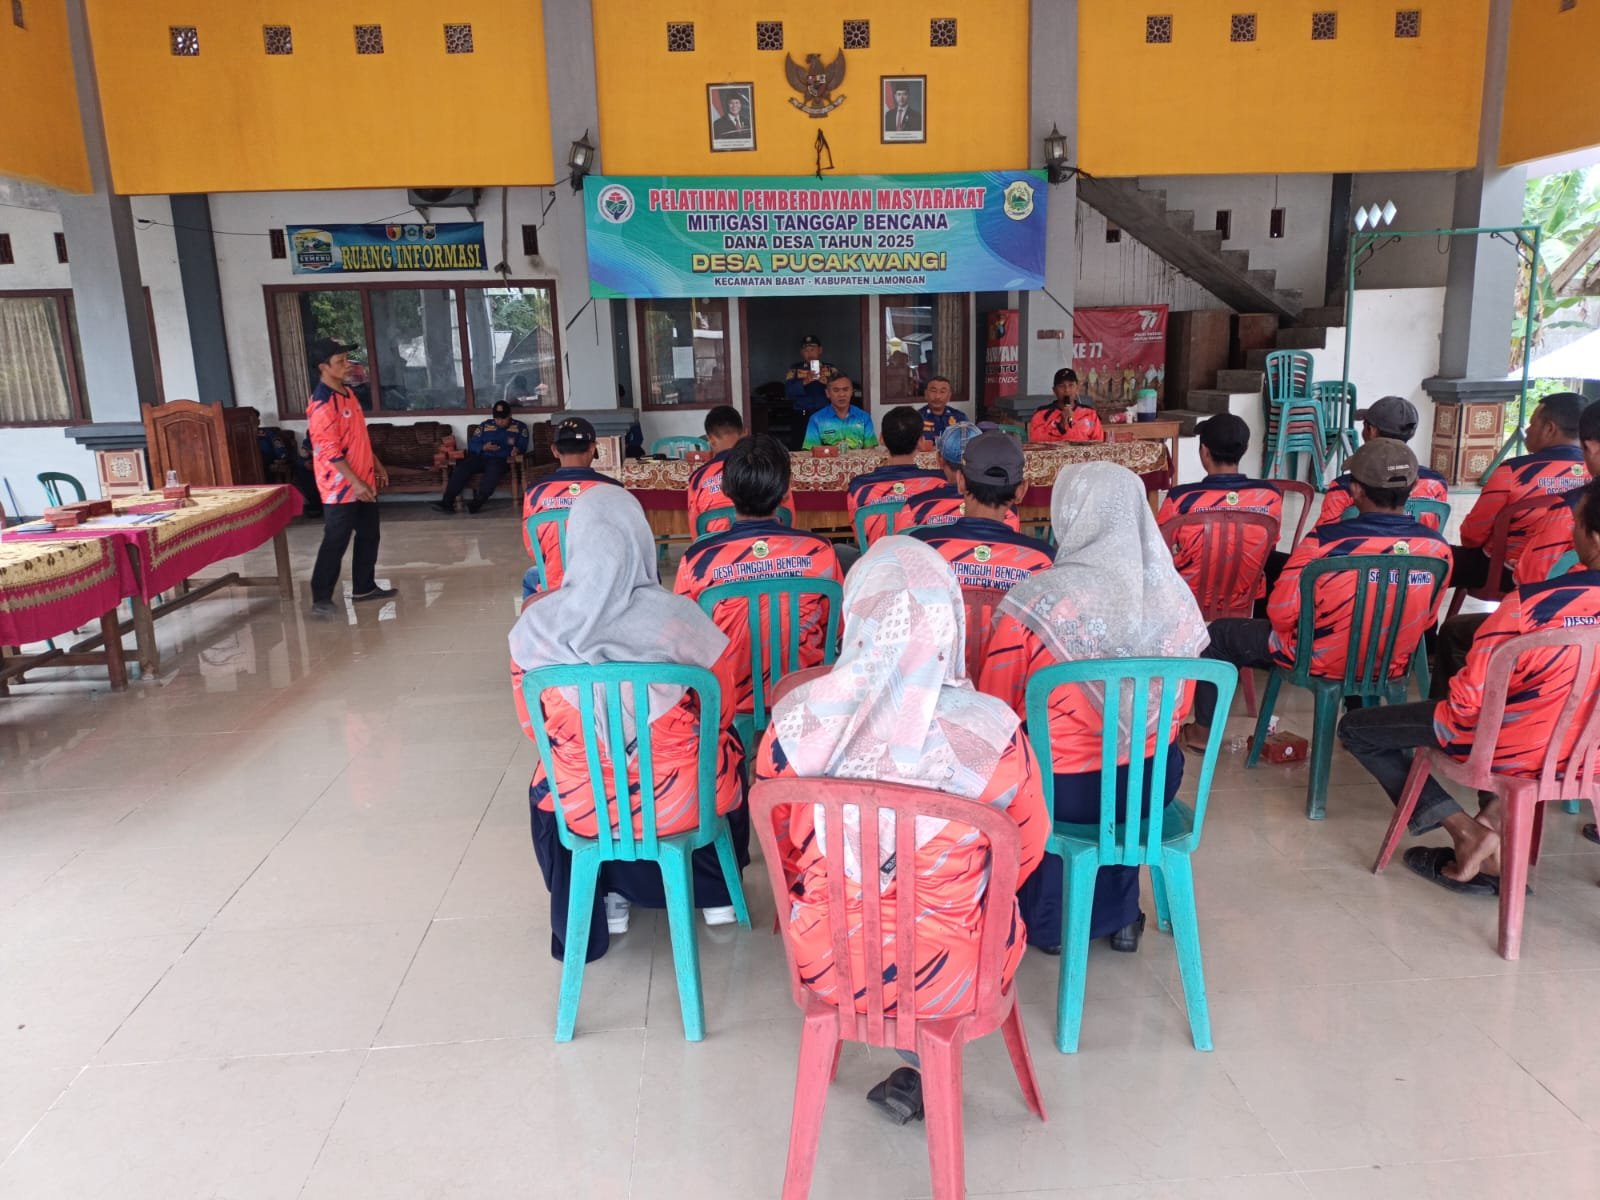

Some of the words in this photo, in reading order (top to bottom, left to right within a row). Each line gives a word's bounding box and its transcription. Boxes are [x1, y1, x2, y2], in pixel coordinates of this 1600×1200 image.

[649, 189, 739, 211] PELATIHAN
[743, 189, 873, 211] PEMBERDAYAAN
[876, 187, 985, 210] MASYARAKAT
[687, 214, 769, 232] MITIGASI
[774, 214, 858, 231] TANGGAP
[863, 213, 949, 230] BENCANA
[724, 235, 768, 249] DANA
[772, 235, 814, 249] DESA
[818, 235, 873, 249] TAHUN
[877, 234, 914, 248] 2025
[341, 245, 392, 270] RUANG
[397, 243, 482, 269] INFORMASI
[692, 254, 763, 273] DESA
[771, 252, 947, 272] PUCAKWANGI
[714, 277, 773, 286] KECAMATAN
[775, 277, 805, 285] BABAT
[814, 276, 870, 285] KABUPATEN
[872, 275, 926, 284] LAMONGAN
[1089, 342, 1103, 358] 77
[713, 565, 734, 580] DESA
[735, 559, 774, 576] TANGGUH
[776, 556, 813, 570] BENCANA
[953, 562, 993, 577] TANGGUH
